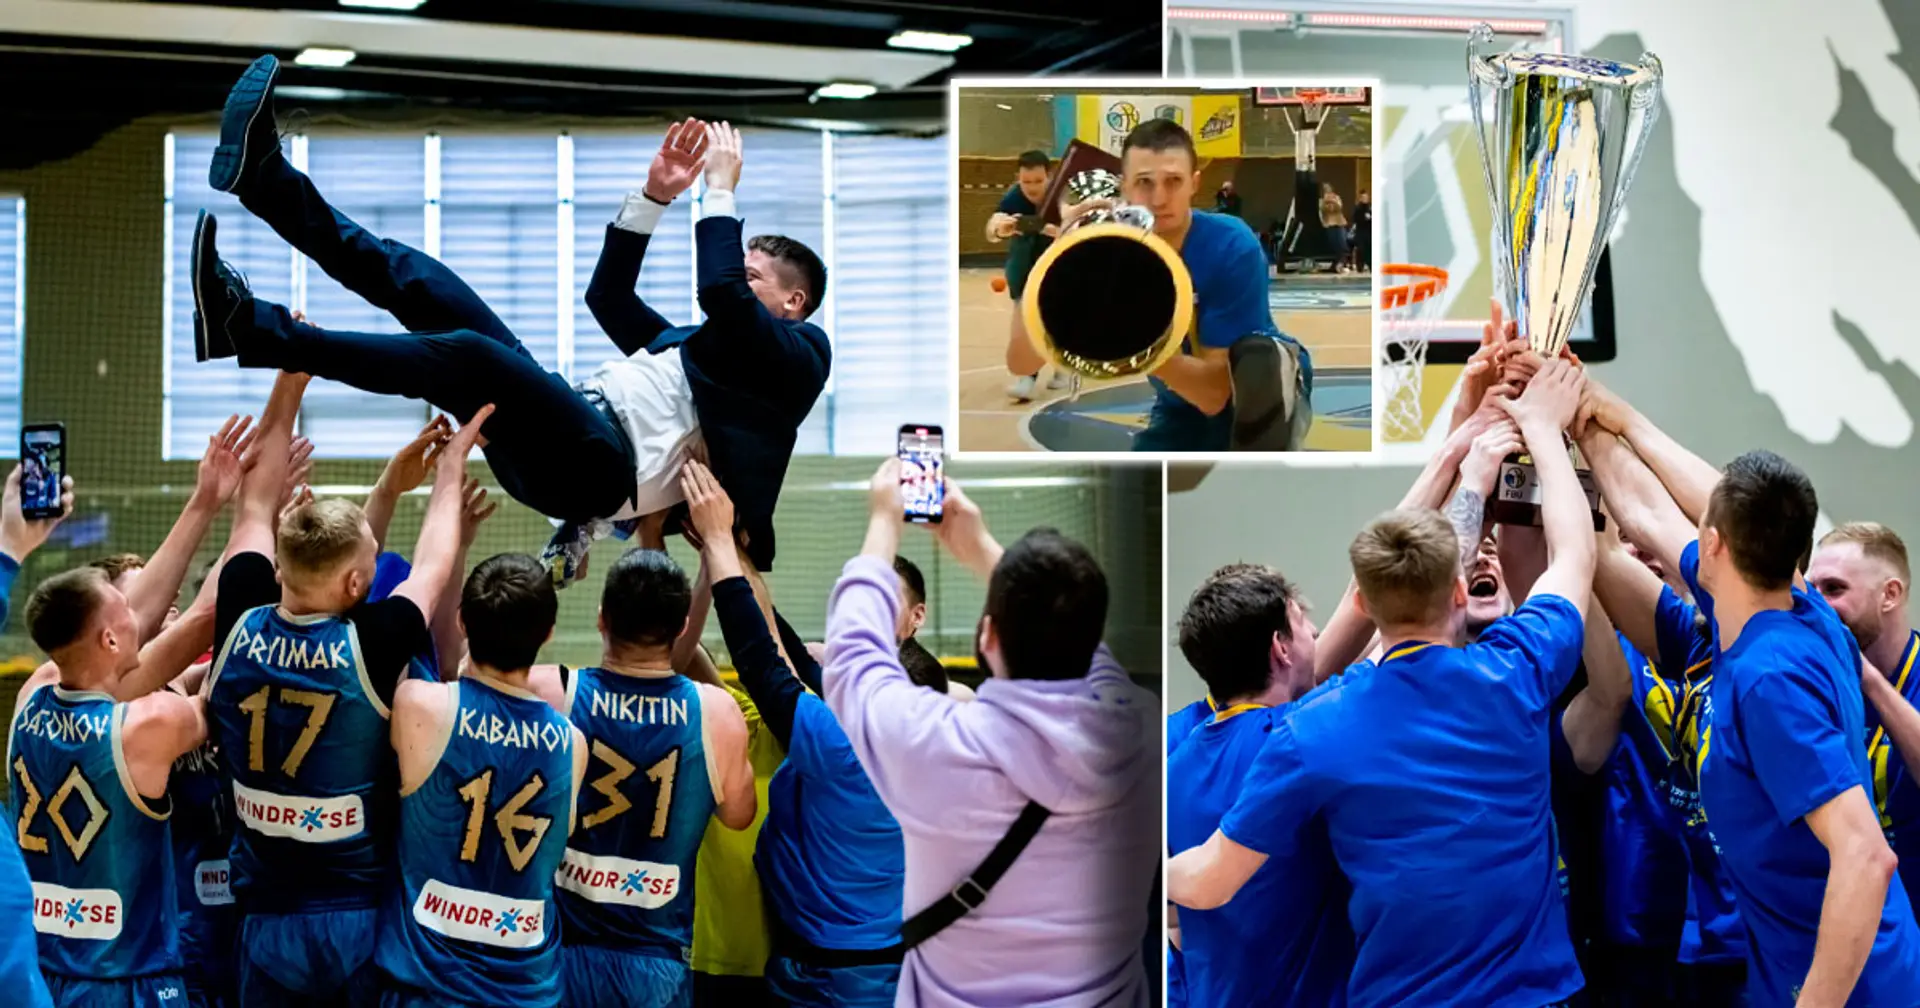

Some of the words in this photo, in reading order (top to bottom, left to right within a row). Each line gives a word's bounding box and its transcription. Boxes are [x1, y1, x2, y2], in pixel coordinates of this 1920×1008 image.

[232, 626, 350, 669] PRYIMAK
[240, 685, 340, 778] 17
[458, 706, 570, 755] KABANOV
[591, 688, 688, 726] NIKITIN
[14, 755, 109, 862] 20
[458, 769, 552, 872] 16
[582, 739, 678, 838] 31
